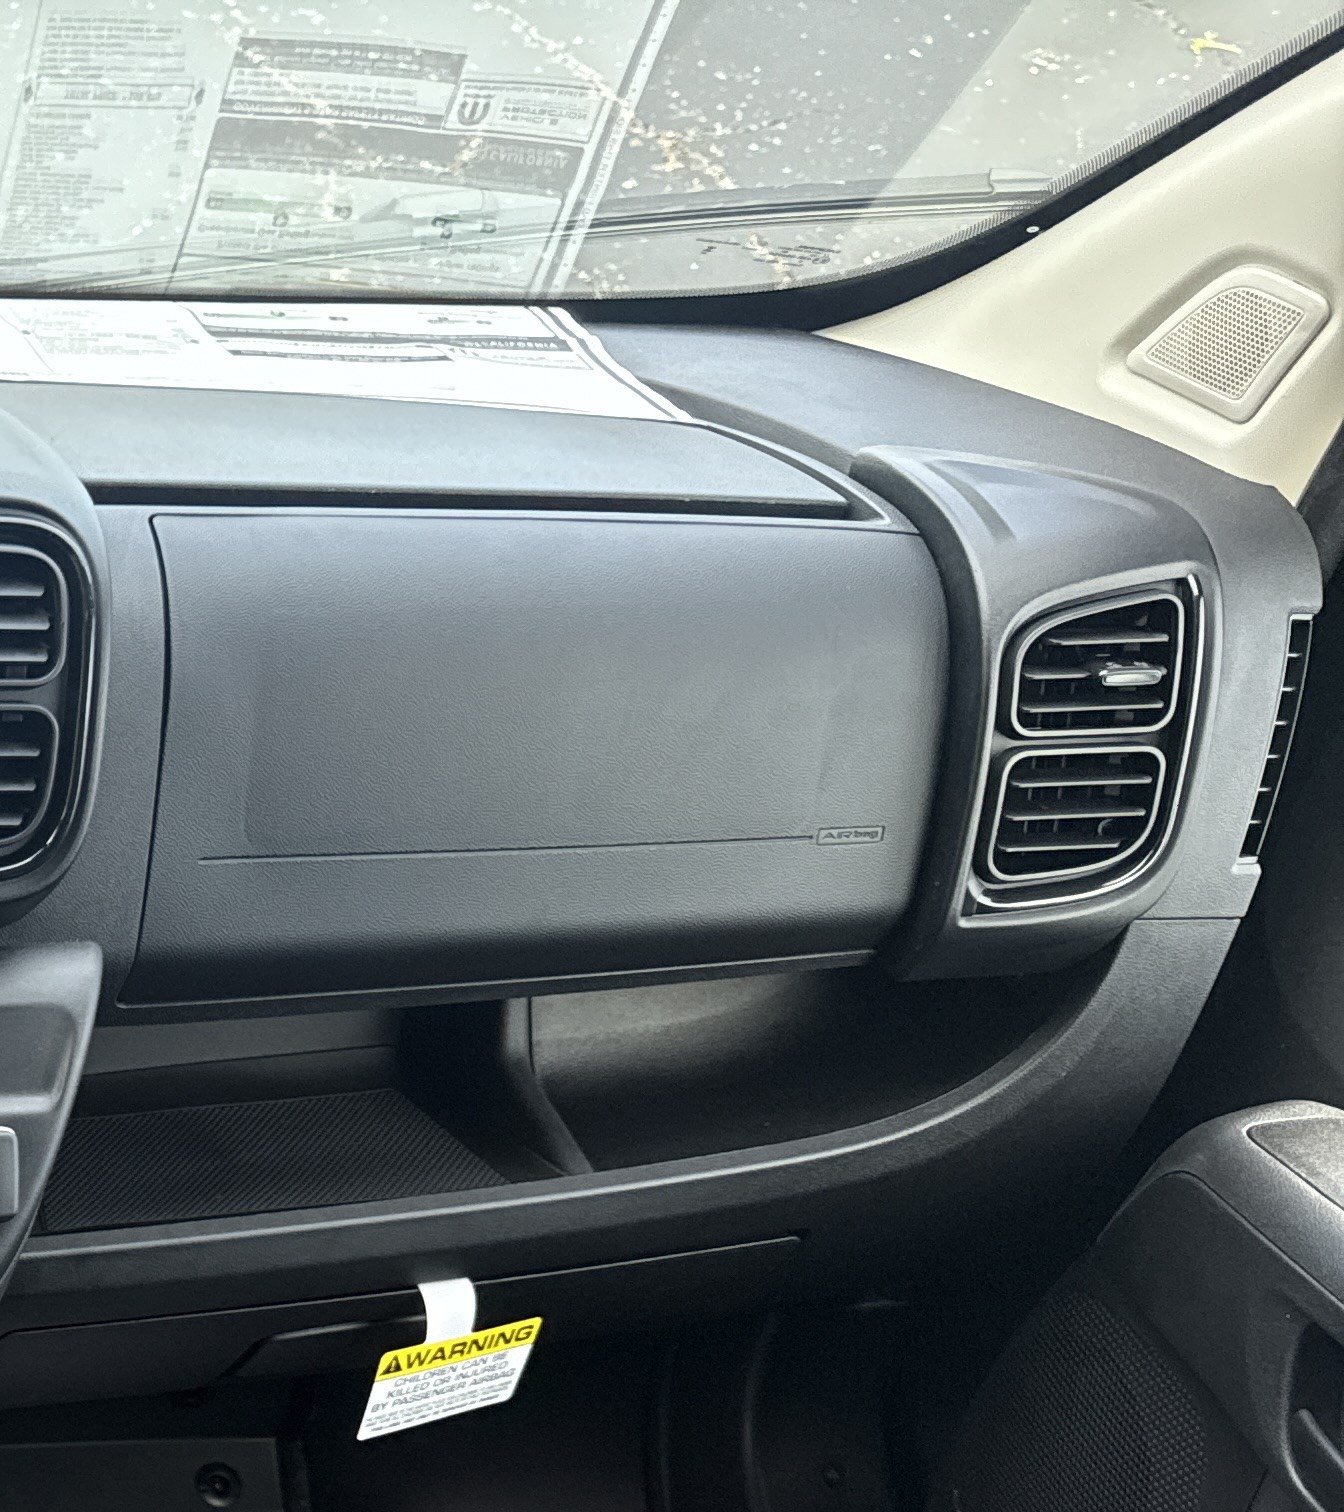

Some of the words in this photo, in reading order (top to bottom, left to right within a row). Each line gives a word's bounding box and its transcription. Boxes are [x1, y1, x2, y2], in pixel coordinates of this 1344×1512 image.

[405, 1324, 534, 1370] WARNING
[386, 1381, 432, 1399] KILLED
[433, 1375, 453, 1388] OR
[454, 1360, 509, 1382] INJURED
[391, 1381, 467, 1407] PASSENGER
[470, 1367, 517, 1386] AIRBAG
[394, 1364, 458, 1387] CHILDREN
[462, 1355, 489, 1371] CAN
